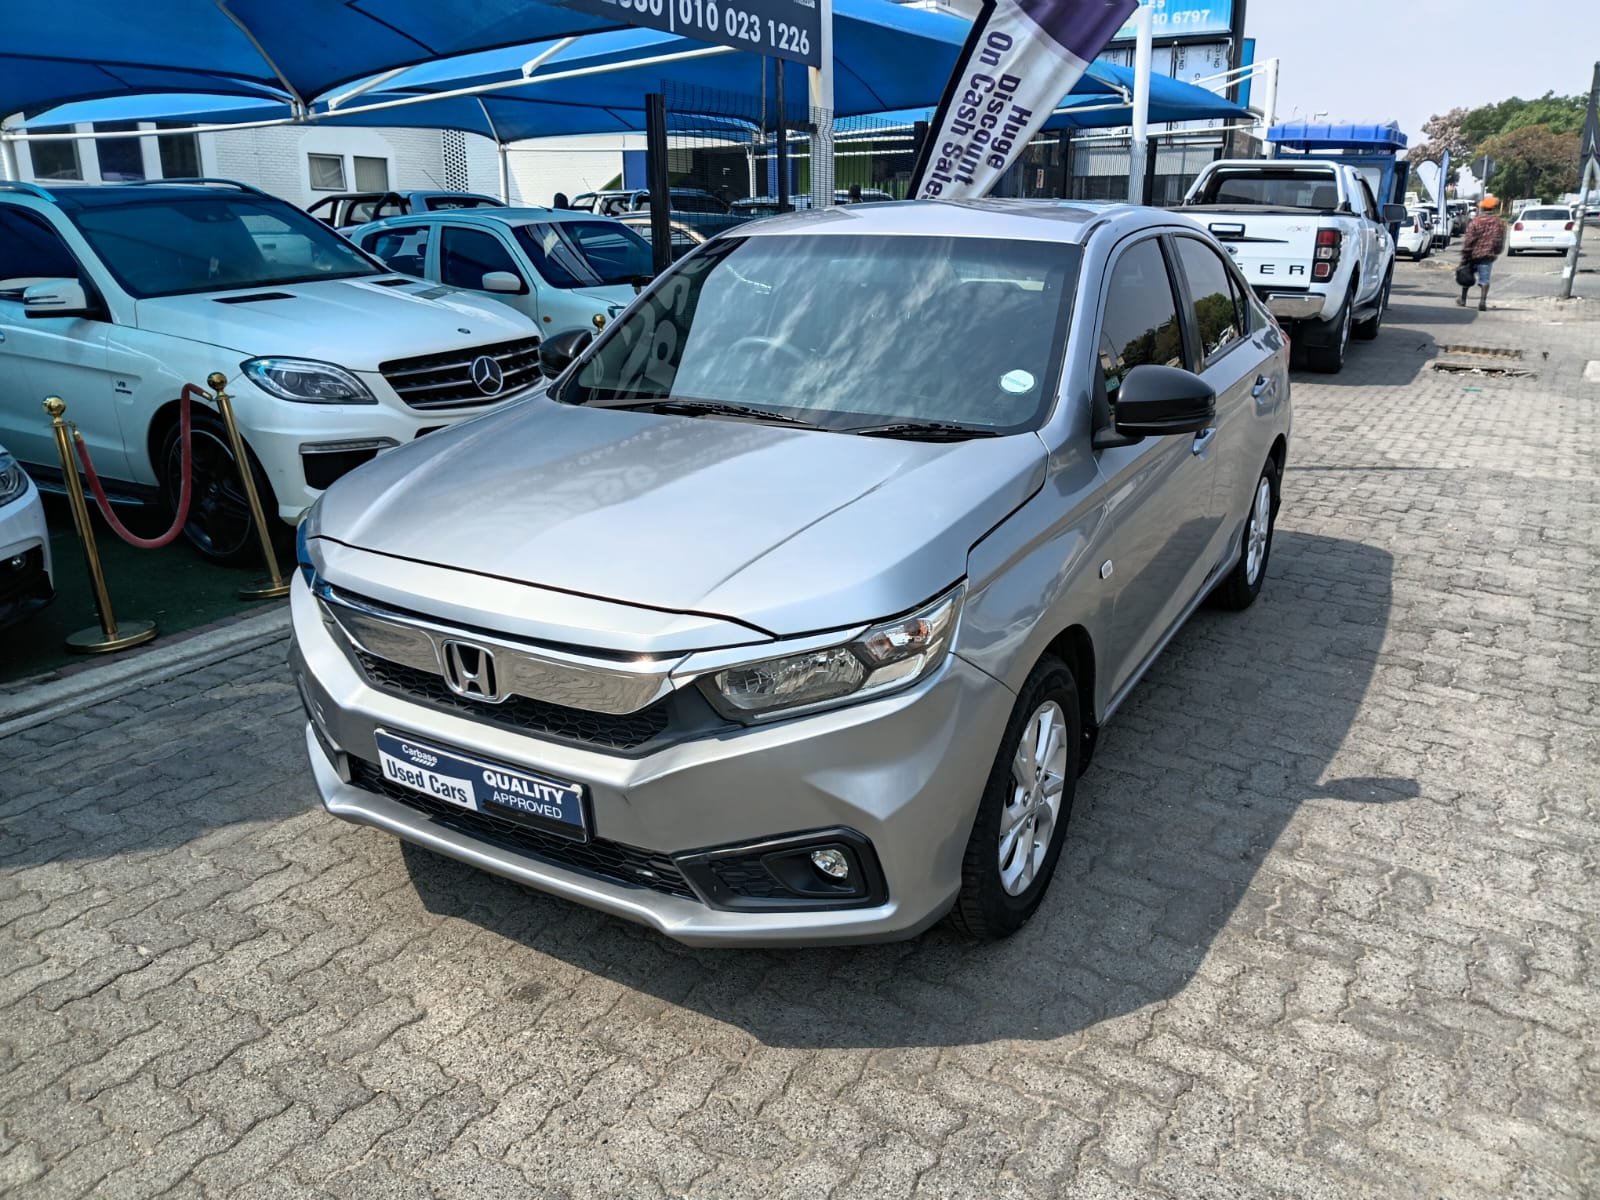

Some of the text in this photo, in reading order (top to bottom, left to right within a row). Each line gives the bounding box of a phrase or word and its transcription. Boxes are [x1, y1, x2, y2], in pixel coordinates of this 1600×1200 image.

[679, 0, 719, 31] 010
[725, 8, 761, 43] 023
[767, 19, 810, 55] 1226
[1172, 9, 1211, 24] 6797
[920, 31, 1013, 200] On Cash Sale
[954, 73, 1022, 187] Discount
[986, 104, 1033, 170] Huge
[401, 744, 438, 764] Carbase
[386, 758, 468, 804] Used Cars
[482, 770, 565, 804] QUALITY
[493, 791, 562, 819] APPROVED
